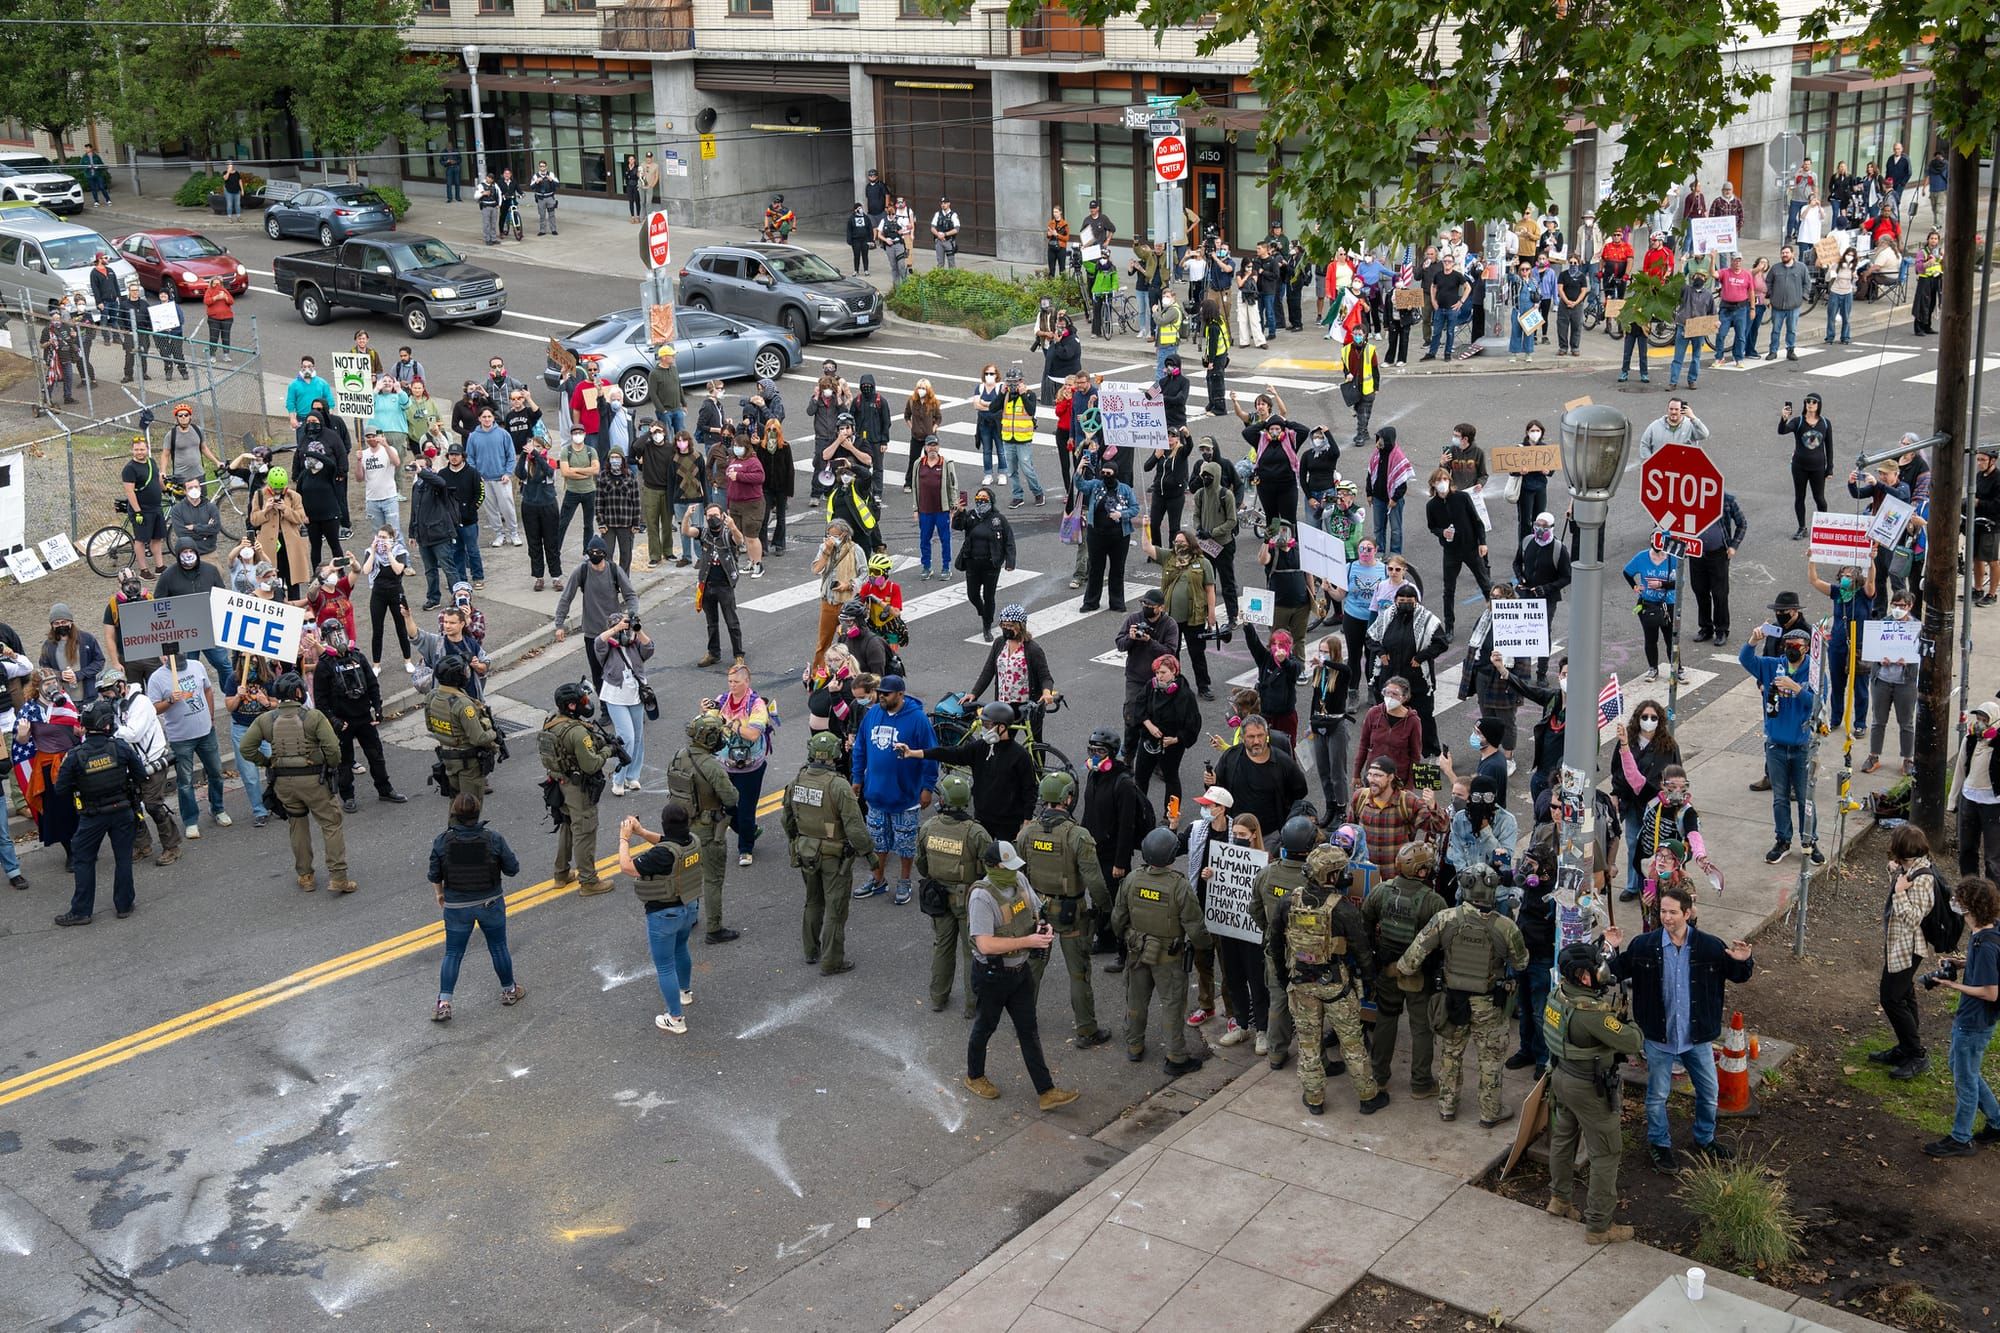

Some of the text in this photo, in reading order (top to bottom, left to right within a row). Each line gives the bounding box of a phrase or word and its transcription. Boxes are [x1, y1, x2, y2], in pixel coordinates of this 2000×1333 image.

[1170, 144, 1181, 152] NOT
[1200, 152, 1220, 160] 4150
[1162, 164, 1180, 174] ENTER
[652, 224, 657, 233] DO
[654, 246, 666, 256] ENTER
[334, 356, 370, 370] NOT UR
[1102, 412, 1152, 429] YES FREE
[1131, 419, 1162, 428] SPEECH
[1106, 430, 1128, 444] NO
[1496, 452, 1520, 471] ICE
[1646, 468, 1718, 509] STOP
[1820, 532, 1834, 540] HUMAN
[1835, 533, 1847, 541] BEING
[153, 600, 171, 612] ICE
[227, 596, 285, 618] ABOLISH
[151, 620, 175, 632] NAZI
[221, 611, 285, 655] ICE
[1883, 621, 1907, 632] ICE
[123, 628, 198, 647] BROWNSHIRTS
[430, 716, 451, 730] POLICE
[88, 756, 112, 768] POLICE
[1034, 841, 1053, 851] POLICE
[685, 852, 699, 868] ERO
[1219, 846, 1251, 861] YOUR
[1215, 872, 1225, 883] IS
[1140, 889, 1160, 901] POLICE
[1209, 882, 1252, 901] IMPORTAN
[1208, 895, 1250, 914] THAN YOU
[1206, 908, 1241, 928] ORDERS
[1545, 1004, 1561, 1024] POLICE
